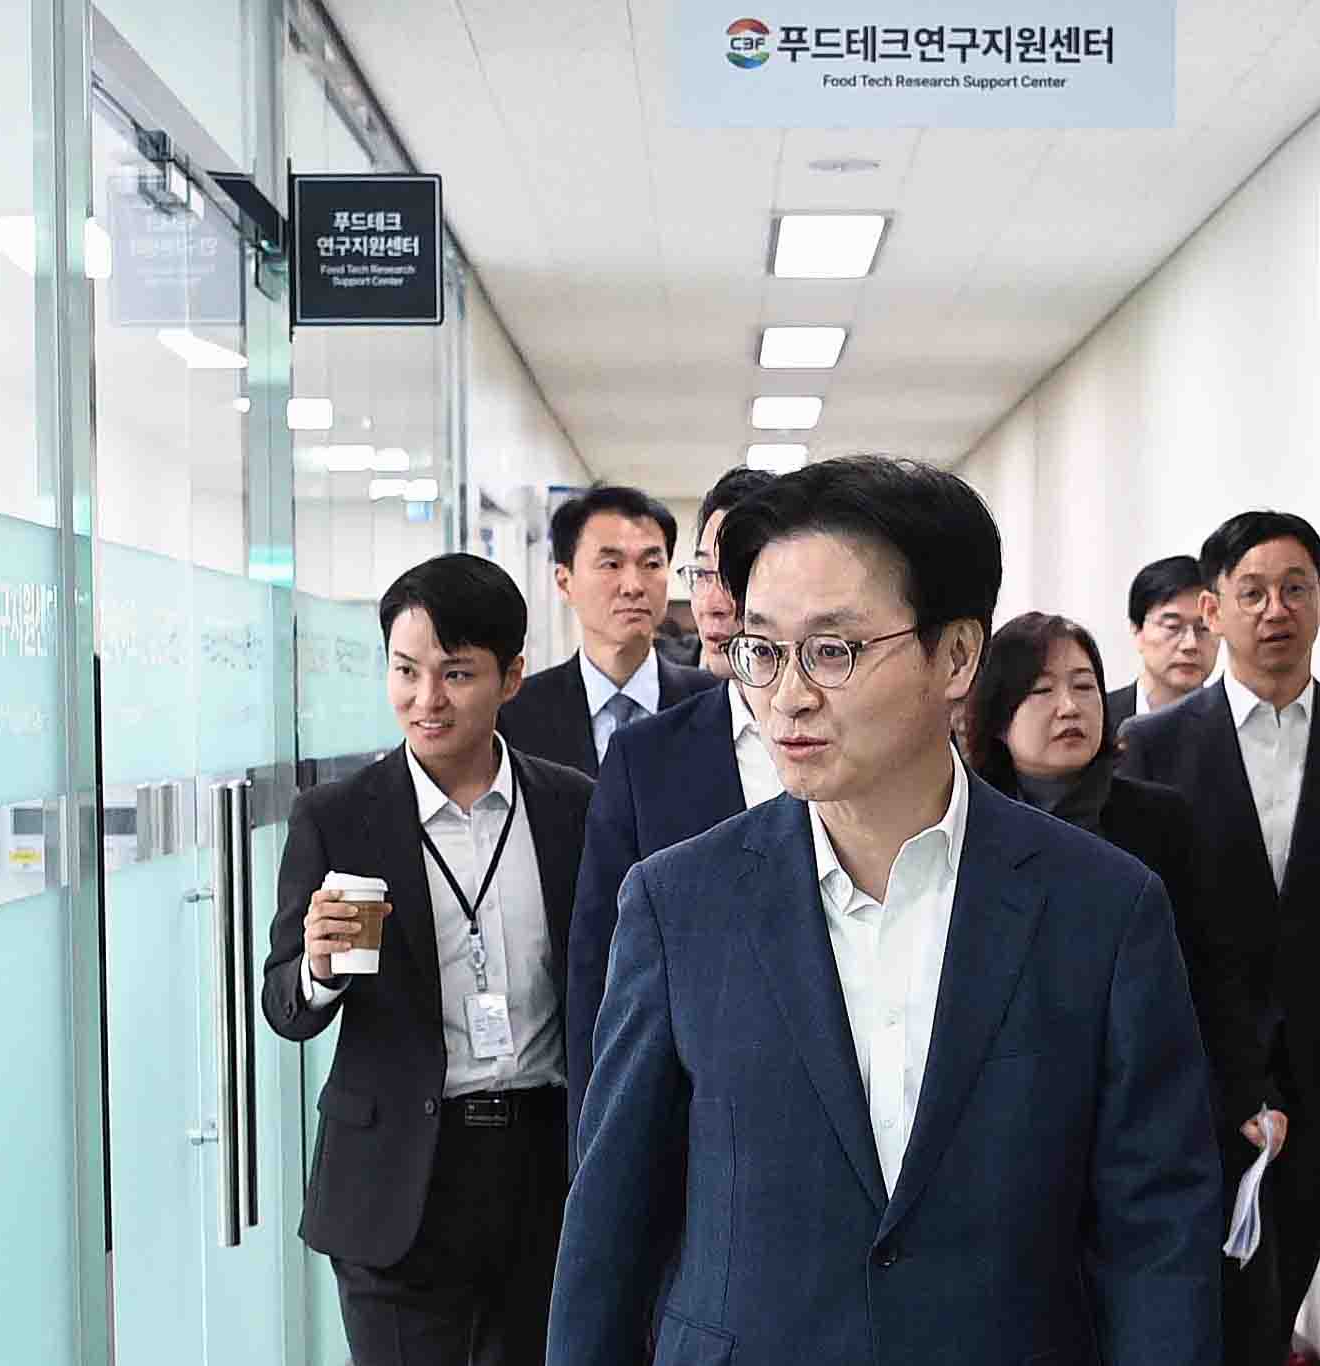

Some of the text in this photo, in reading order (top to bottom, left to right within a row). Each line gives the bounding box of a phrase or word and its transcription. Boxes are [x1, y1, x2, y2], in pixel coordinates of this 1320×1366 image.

[777, 25, 1114, 64] 푸드테크연구지원센터
[823, 74, 1066, 90] Food Tech Research Support Center
[333, 210, 402, 233] 푸드테크
[316, 235, 420, 257] 연구지원센터
